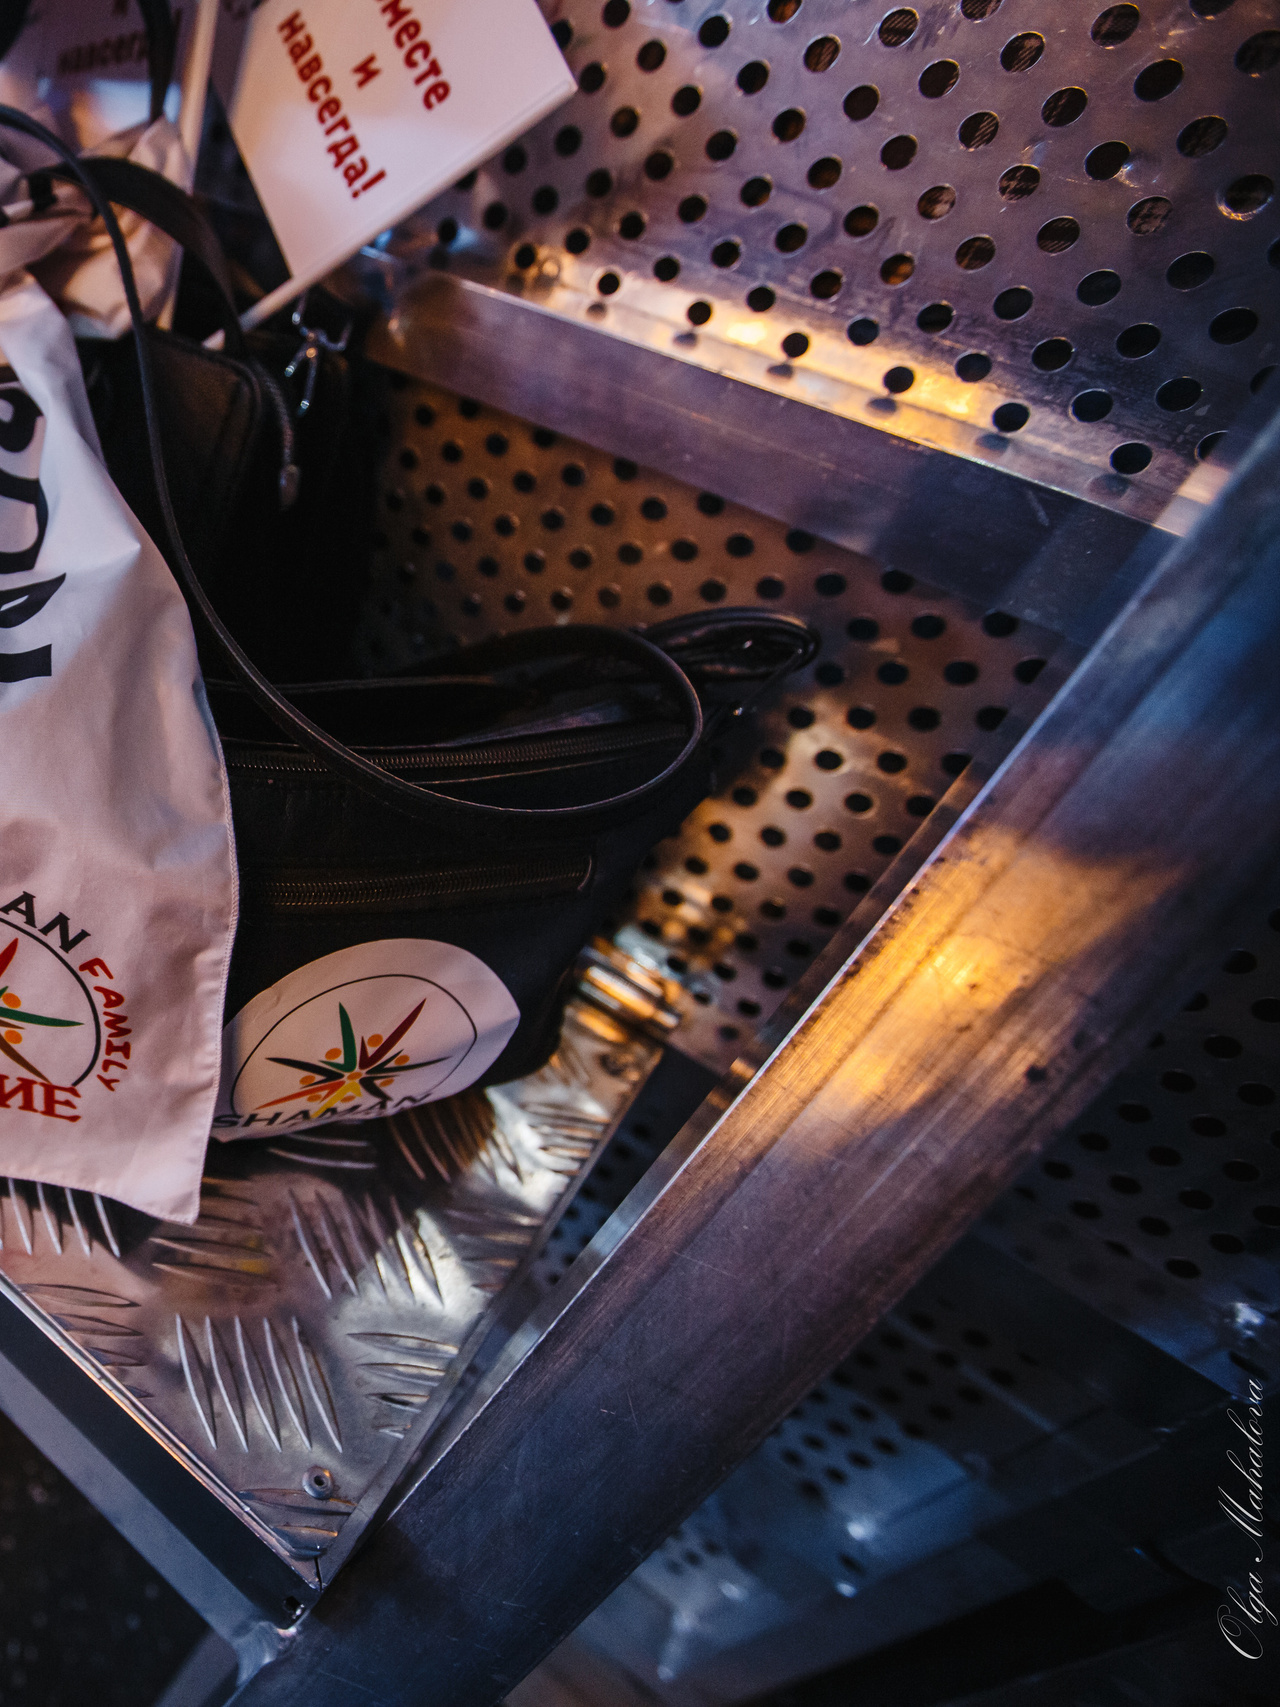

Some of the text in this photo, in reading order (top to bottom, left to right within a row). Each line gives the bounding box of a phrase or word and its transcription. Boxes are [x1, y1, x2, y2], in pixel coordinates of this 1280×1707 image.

[277, 9, 387, 199] навсегда!
[352, 53, 383, 89] и
[376, 0, 451, 111] месте
[78, 957, 132, 1092] FAMILY
